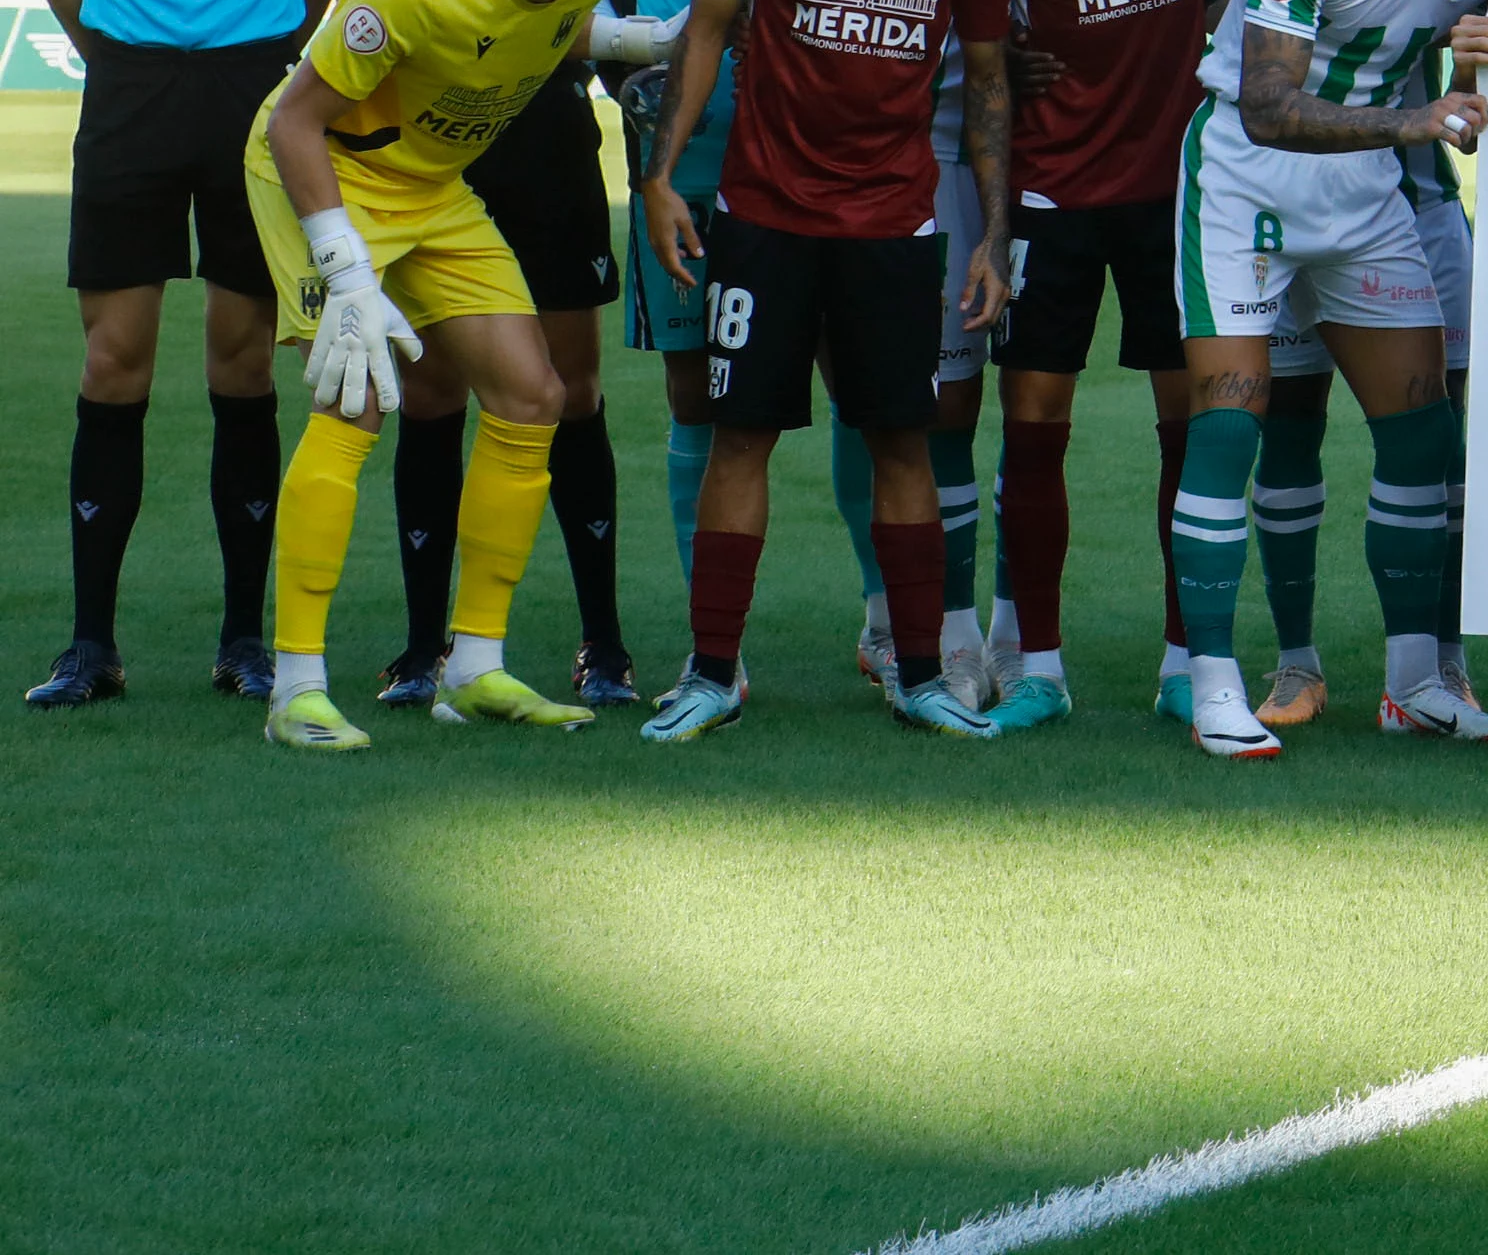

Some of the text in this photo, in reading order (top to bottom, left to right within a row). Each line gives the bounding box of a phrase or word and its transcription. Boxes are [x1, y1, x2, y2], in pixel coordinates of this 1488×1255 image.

[792, 3, 927, 51] MÉRIDA
[1079, 5, 1138, 26] PATRIMONIO
[1139, 1, 1153, 11] DE
[844, 41, 858, 54] DE
[858, 44, 871, 56] LA
[1253, 210, 1284, 253] 8
[705, 281, 754, 350] 18
[1231, 301, 1278, 315] GIVOVA
